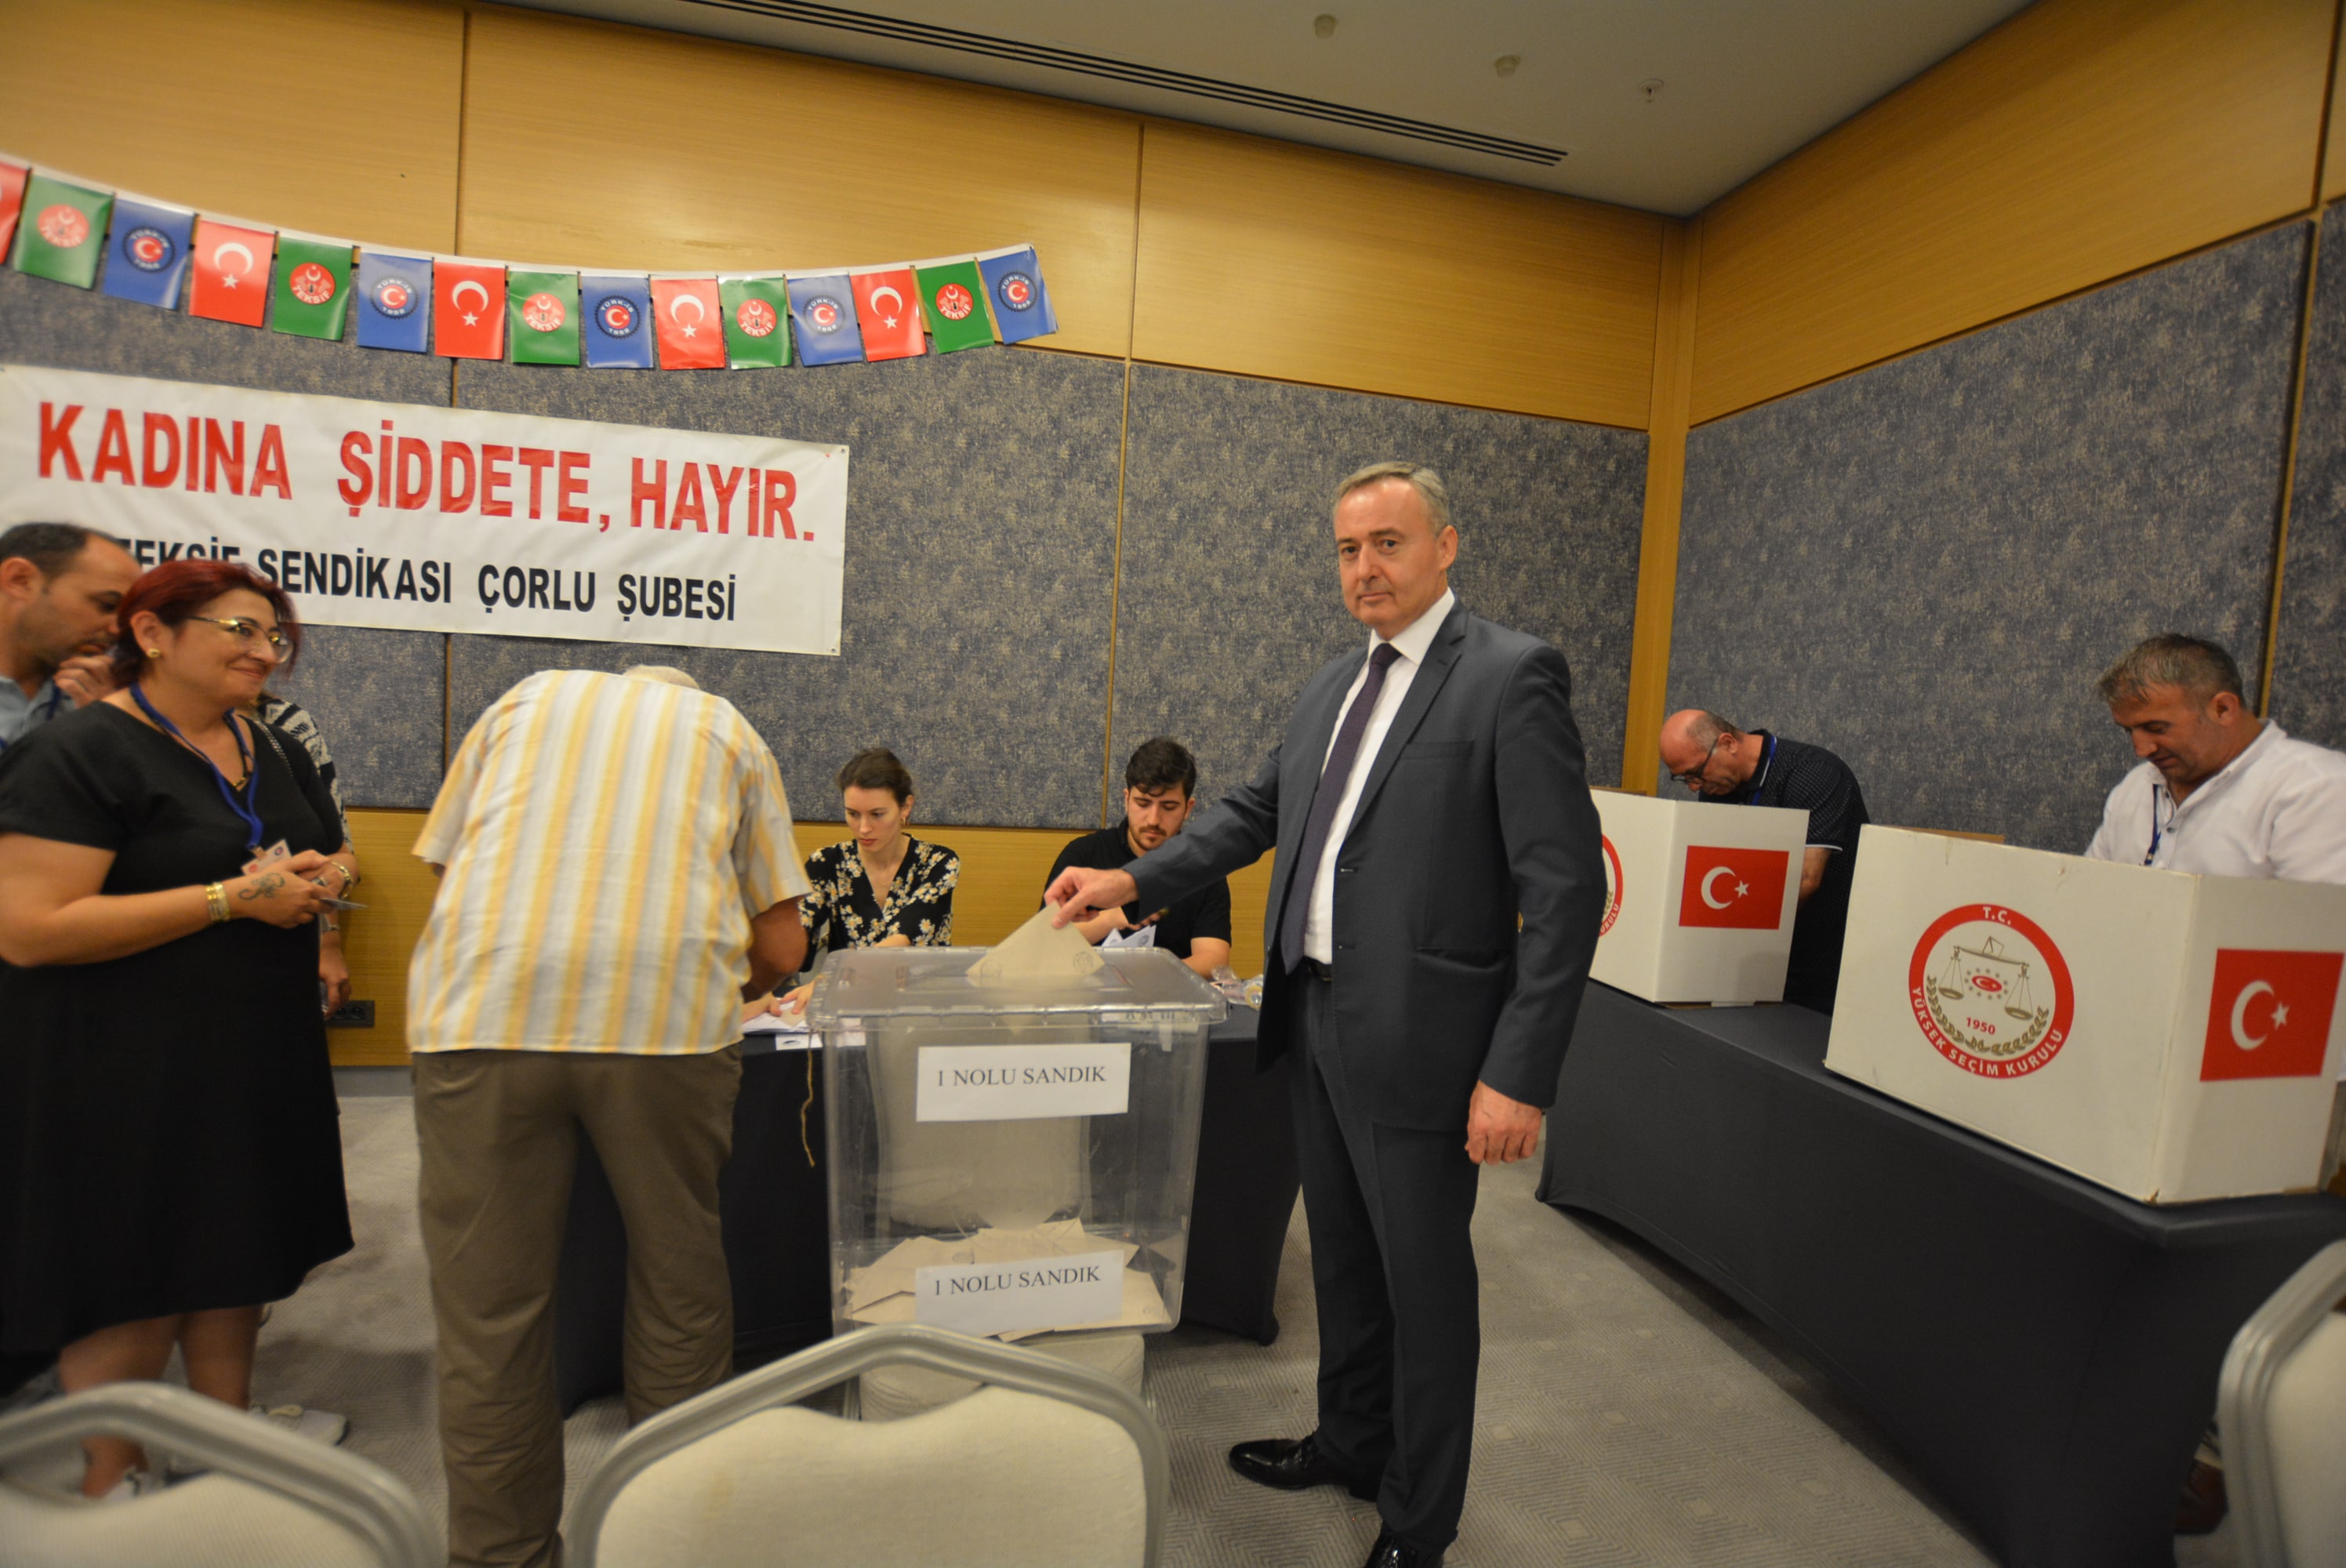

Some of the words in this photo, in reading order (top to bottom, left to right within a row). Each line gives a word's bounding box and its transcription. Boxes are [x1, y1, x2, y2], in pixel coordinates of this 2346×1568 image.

[38, 401, 292, 500] KADINA
[337, 419, 610, 532] ŞİDDETE,
[630, 457, 815, 542] HAYIR.
[258, 547, 451, 604] SENDİKASI
[478, 564, 596, 614] ÇORLU
[617, 574, 736, 622] ŞUBESİ
[1600, 903, 1620, 933] URULU
[1982, 906, 2012, 926] T.C.
[1912, 986, 1948, 1051] YÜKSEK
[1948, 1048, 1999, 1077] SEÇİM
[2005, 1029, 2064, 1076] KURULU
[1966, 1017, 1996, 1036] 1950
[937, 1070, 944, 1087] 1
[953, 1068, 1017, 1087] NOLU
[1022, 1065, 1108, 1085] SANDIK
[934, 1279, 941, 1296] 1
[950, 1273, 1013, 1294] NOLU
[1019, 1265, 1102, 1288] SANDIK
